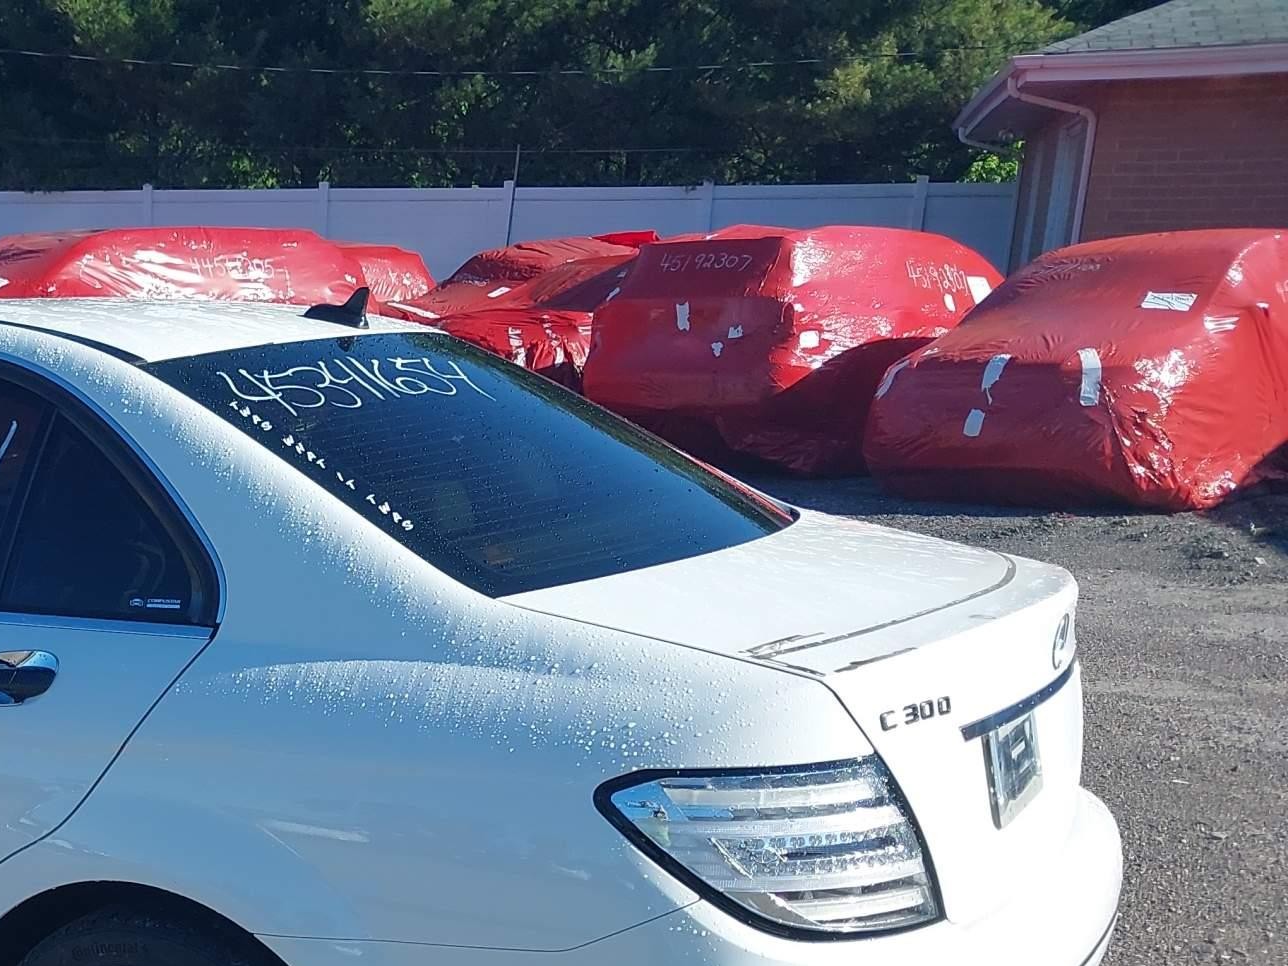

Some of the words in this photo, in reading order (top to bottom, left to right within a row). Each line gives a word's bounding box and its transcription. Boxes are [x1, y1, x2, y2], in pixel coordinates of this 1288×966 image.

[660, 253, 753, 272] 45192307
[216, 356, 497, 416] 45341654
[879, 710, 898, 732] C
[903, 696, 952, 725] 300
